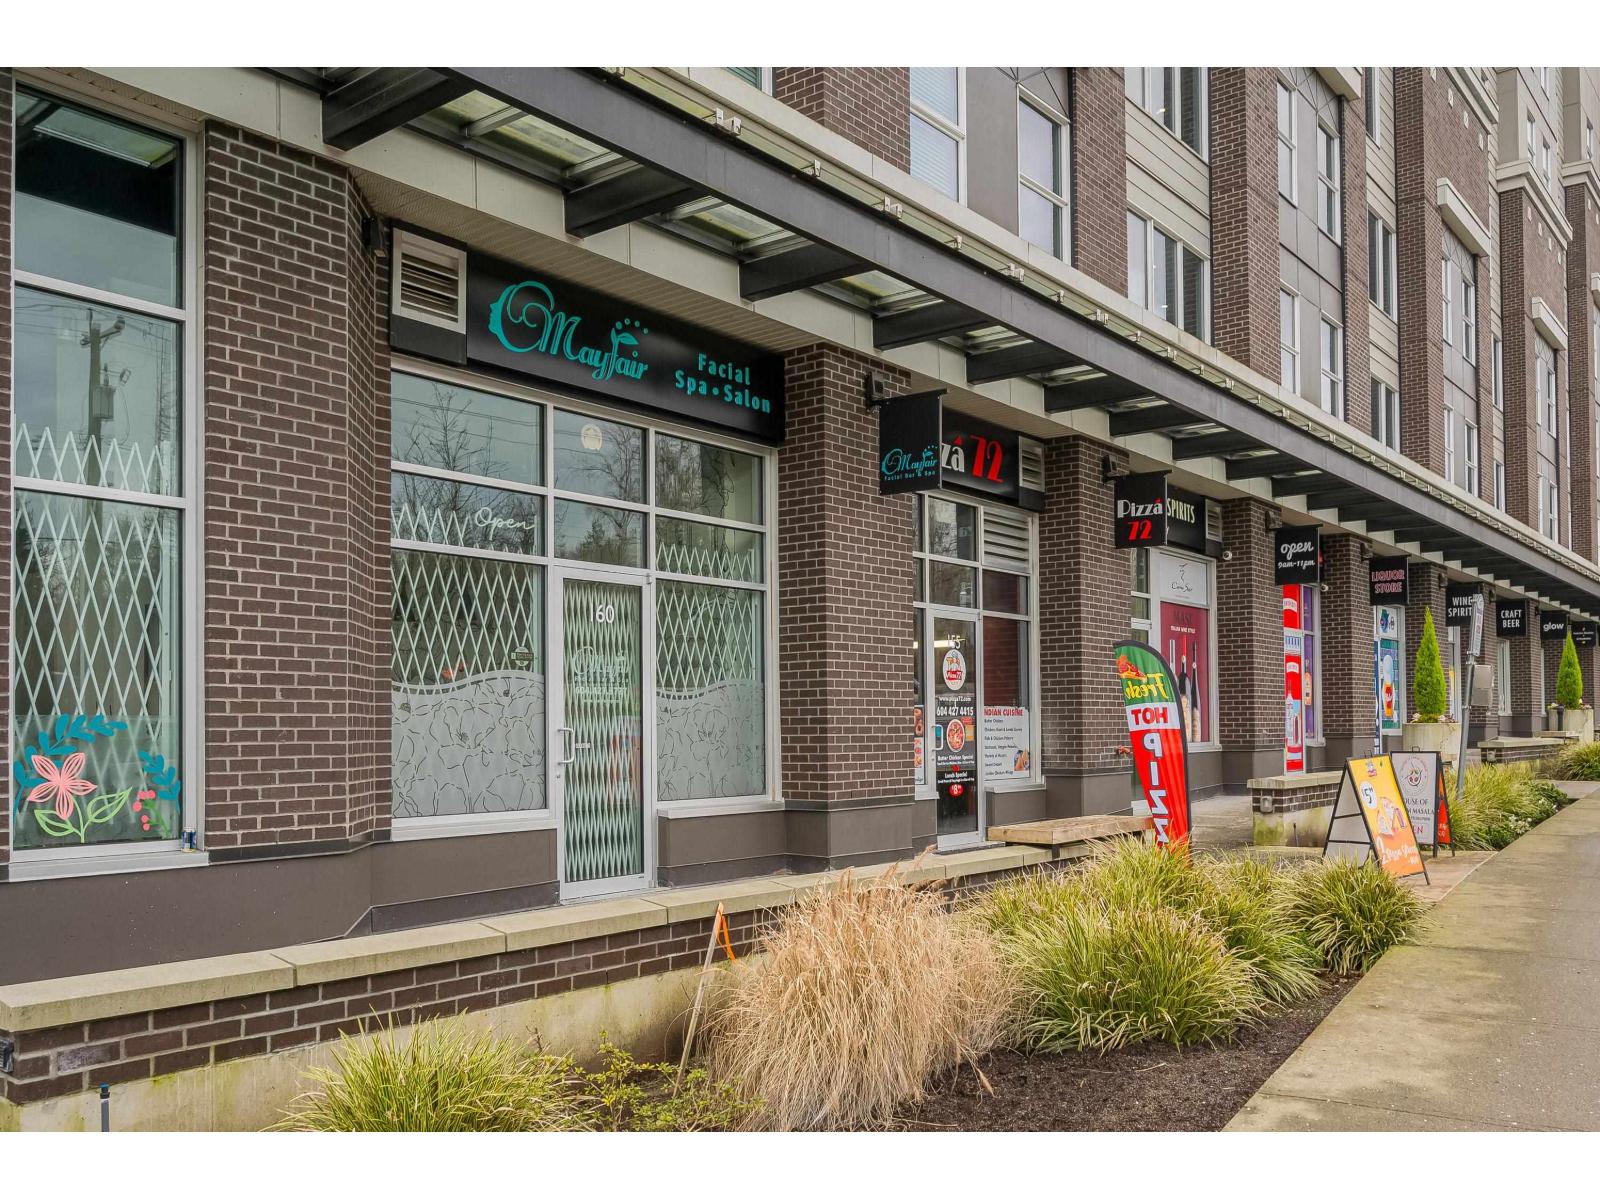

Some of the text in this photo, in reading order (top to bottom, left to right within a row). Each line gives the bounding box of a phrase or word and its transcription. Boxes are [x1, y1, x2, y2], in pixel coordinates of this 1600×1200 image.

[488, 281, 649, 381] Mayfair
[698, 353, 751, 386] Facial
[675, 370, 771, 414] Spa Salon
[882, 446, 938, 474] Mayfair
[970, 435, 1004, 484] 72
[1166, 497, 1195, 524] SPIRITS
[474, 506, 535, 540] Open
[1128, 519, 1152, 540] 72
[1280, 541, 1314, 561] open
[1278, 560, 1316, 570] 9am-11pm
[1372, 570, 1404, 582] LIQUOR
[1374, 582, 1402, 594] STORE
[1452, 596, 1472, 606] WINE
[590, 604, 615, 623] 160
[1448, 607, 1472, 617] SPIRIT
[1501, 610, 1522, 619] CRAFT
[1502, 618, 1520, 628] BEER
[1543, 622, 1564, 632] glow
[937, 706, 974, 716] 604 427 4415
